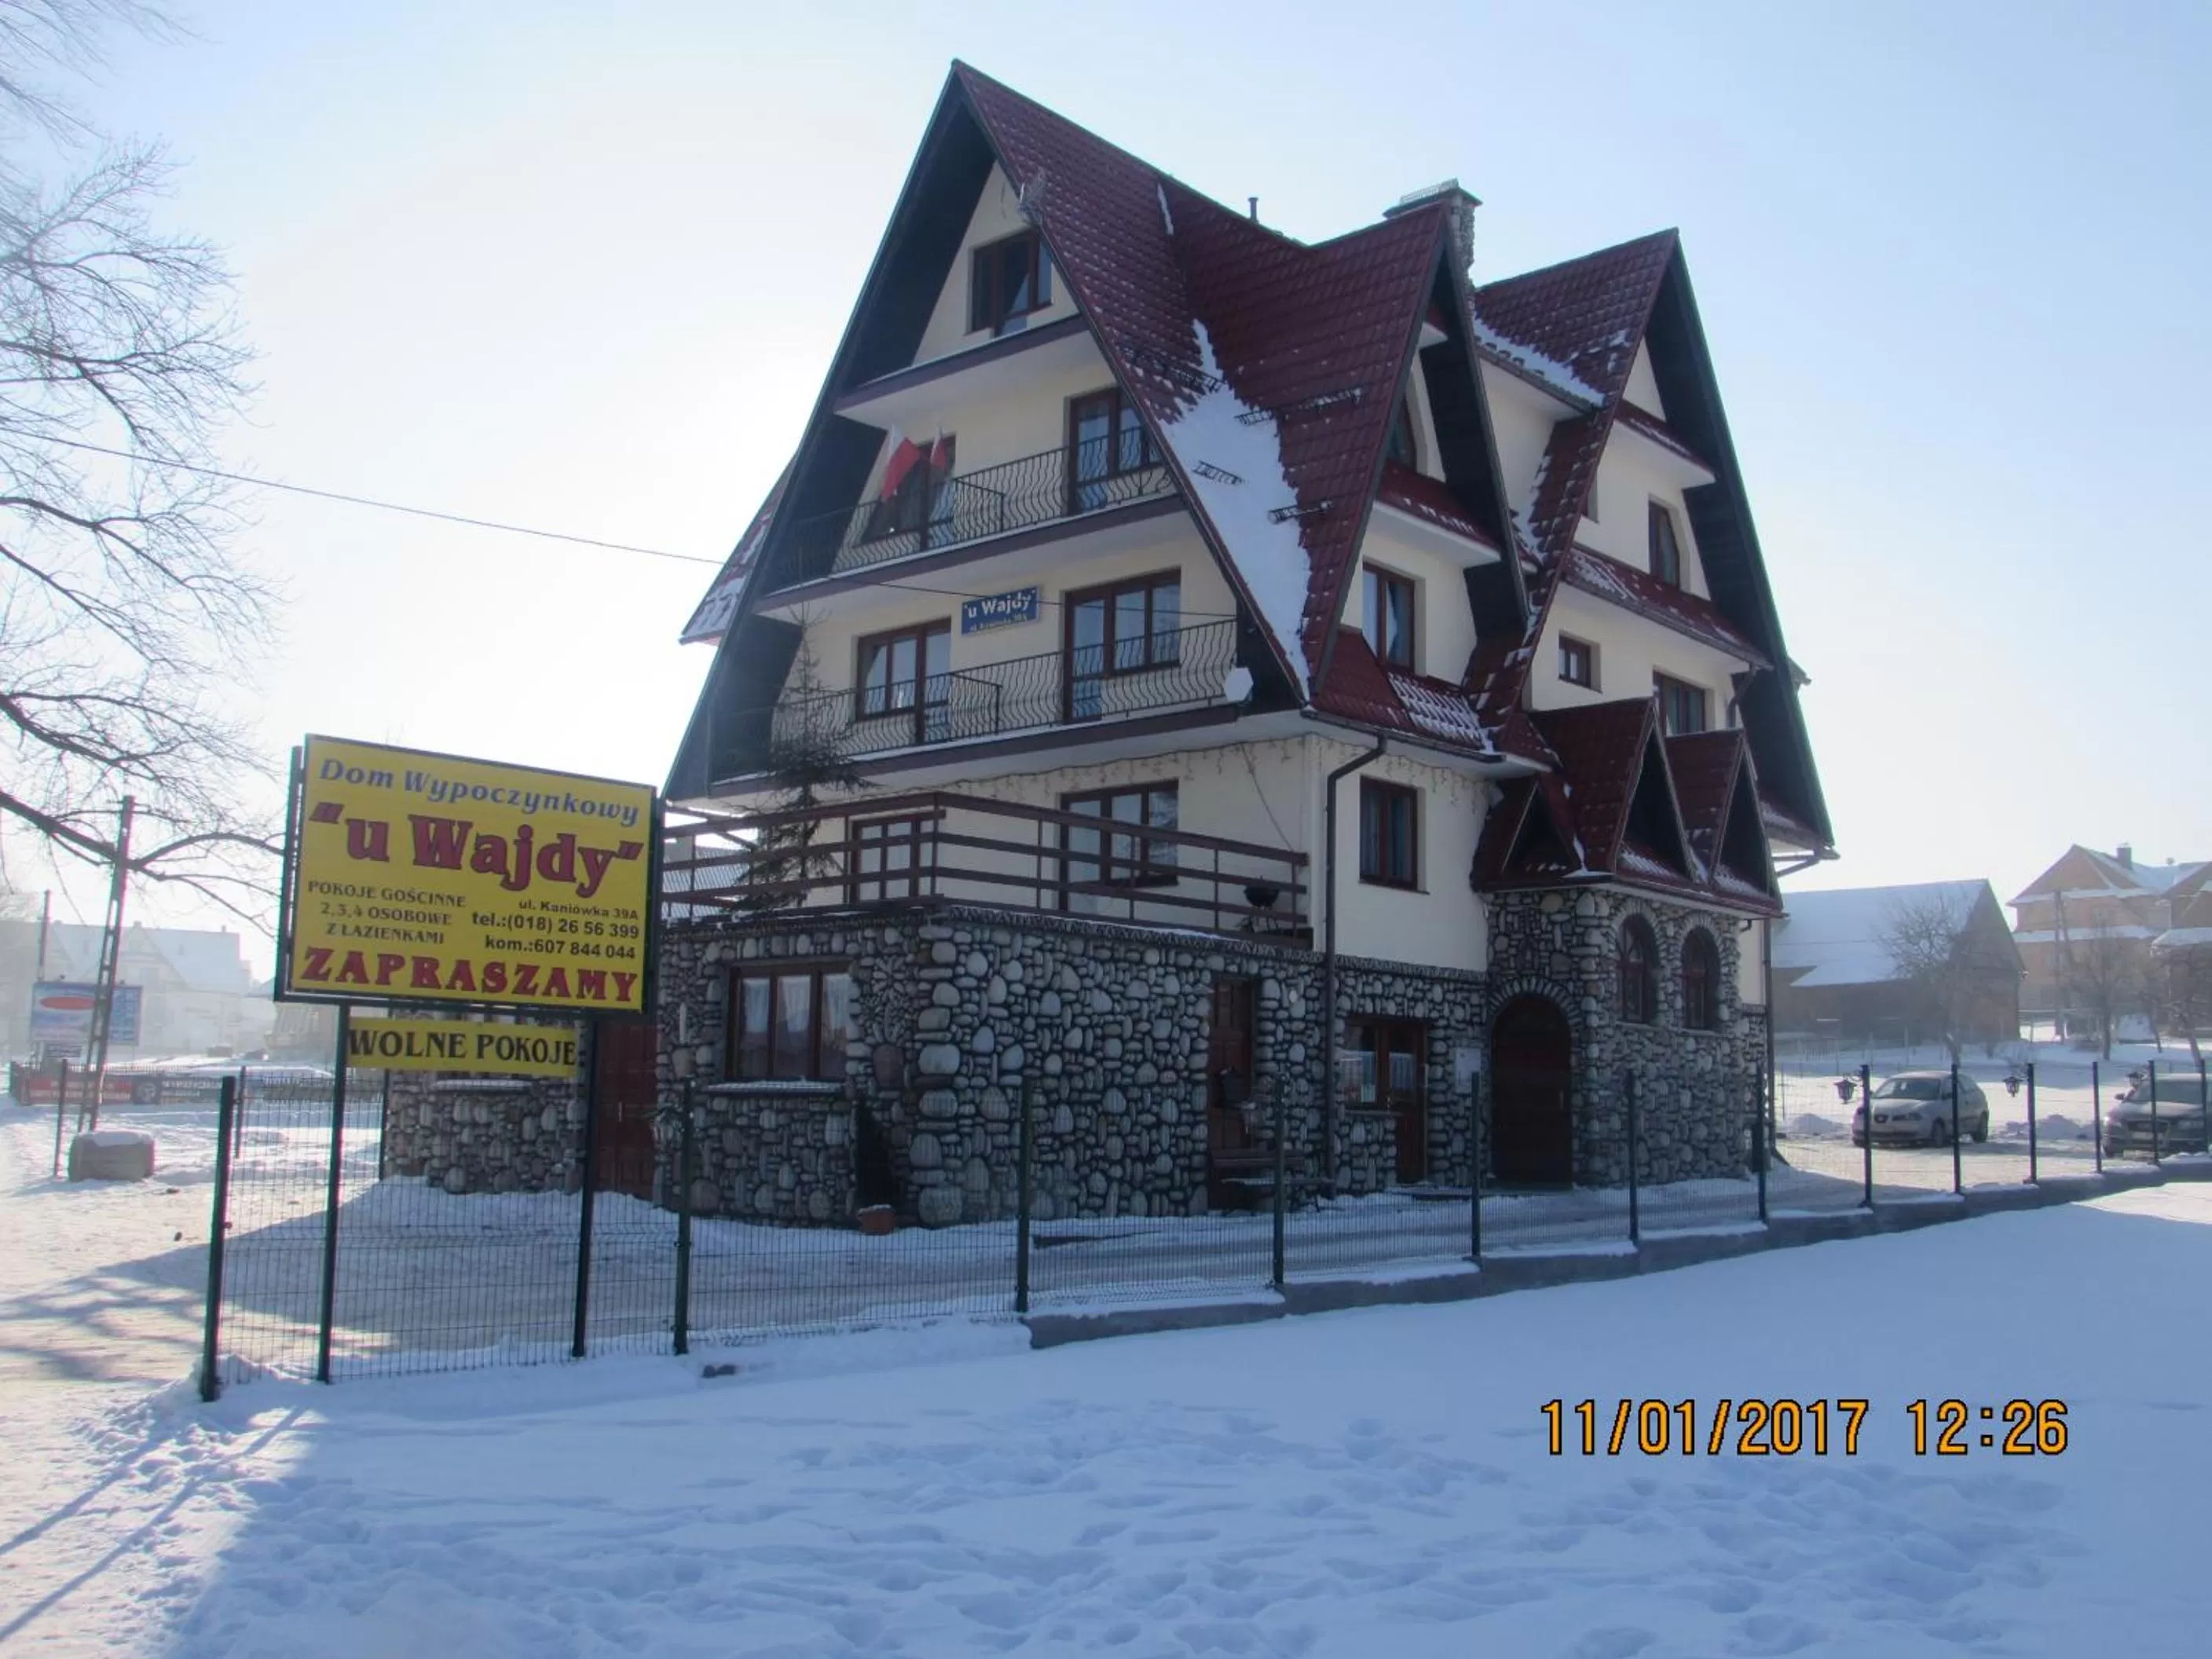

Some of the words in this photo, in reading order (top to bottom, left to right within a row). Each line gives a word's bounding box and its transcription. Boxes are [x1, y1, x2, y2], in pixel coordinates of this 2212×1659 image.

[319, 758, 394, 789] Dom
[405, 770, 639, 827] Wypoczynkowy
[408, 814, 645, 899] Wajdy"
[308, 880, 376, 899] POKOJE
[381, 886, 467, 907] GOŚCINNE
[368, 906, 452, 925] OSOBOWE
[518, 899, 536, 911] ul.
[613, 907, 639, 921] 39A
[326, 922, 337, 936] Z
[472, 911, 553, 933] tel.:(018)
[558, 918, 579, 934] 26
[584, 921, 604, 936] 56
[609, 923, 639, 939] 399
[485, 935, 566, 954] kom.:607
[569, 942, 601, 957] 844
[606, 944, 635, 959] 044
[300, 946, 638, 1002] ZAPRASZAMY
[350, 1029, 467, 1058] WOLNE
[475, 1034, 576, 1066] POKOJE
